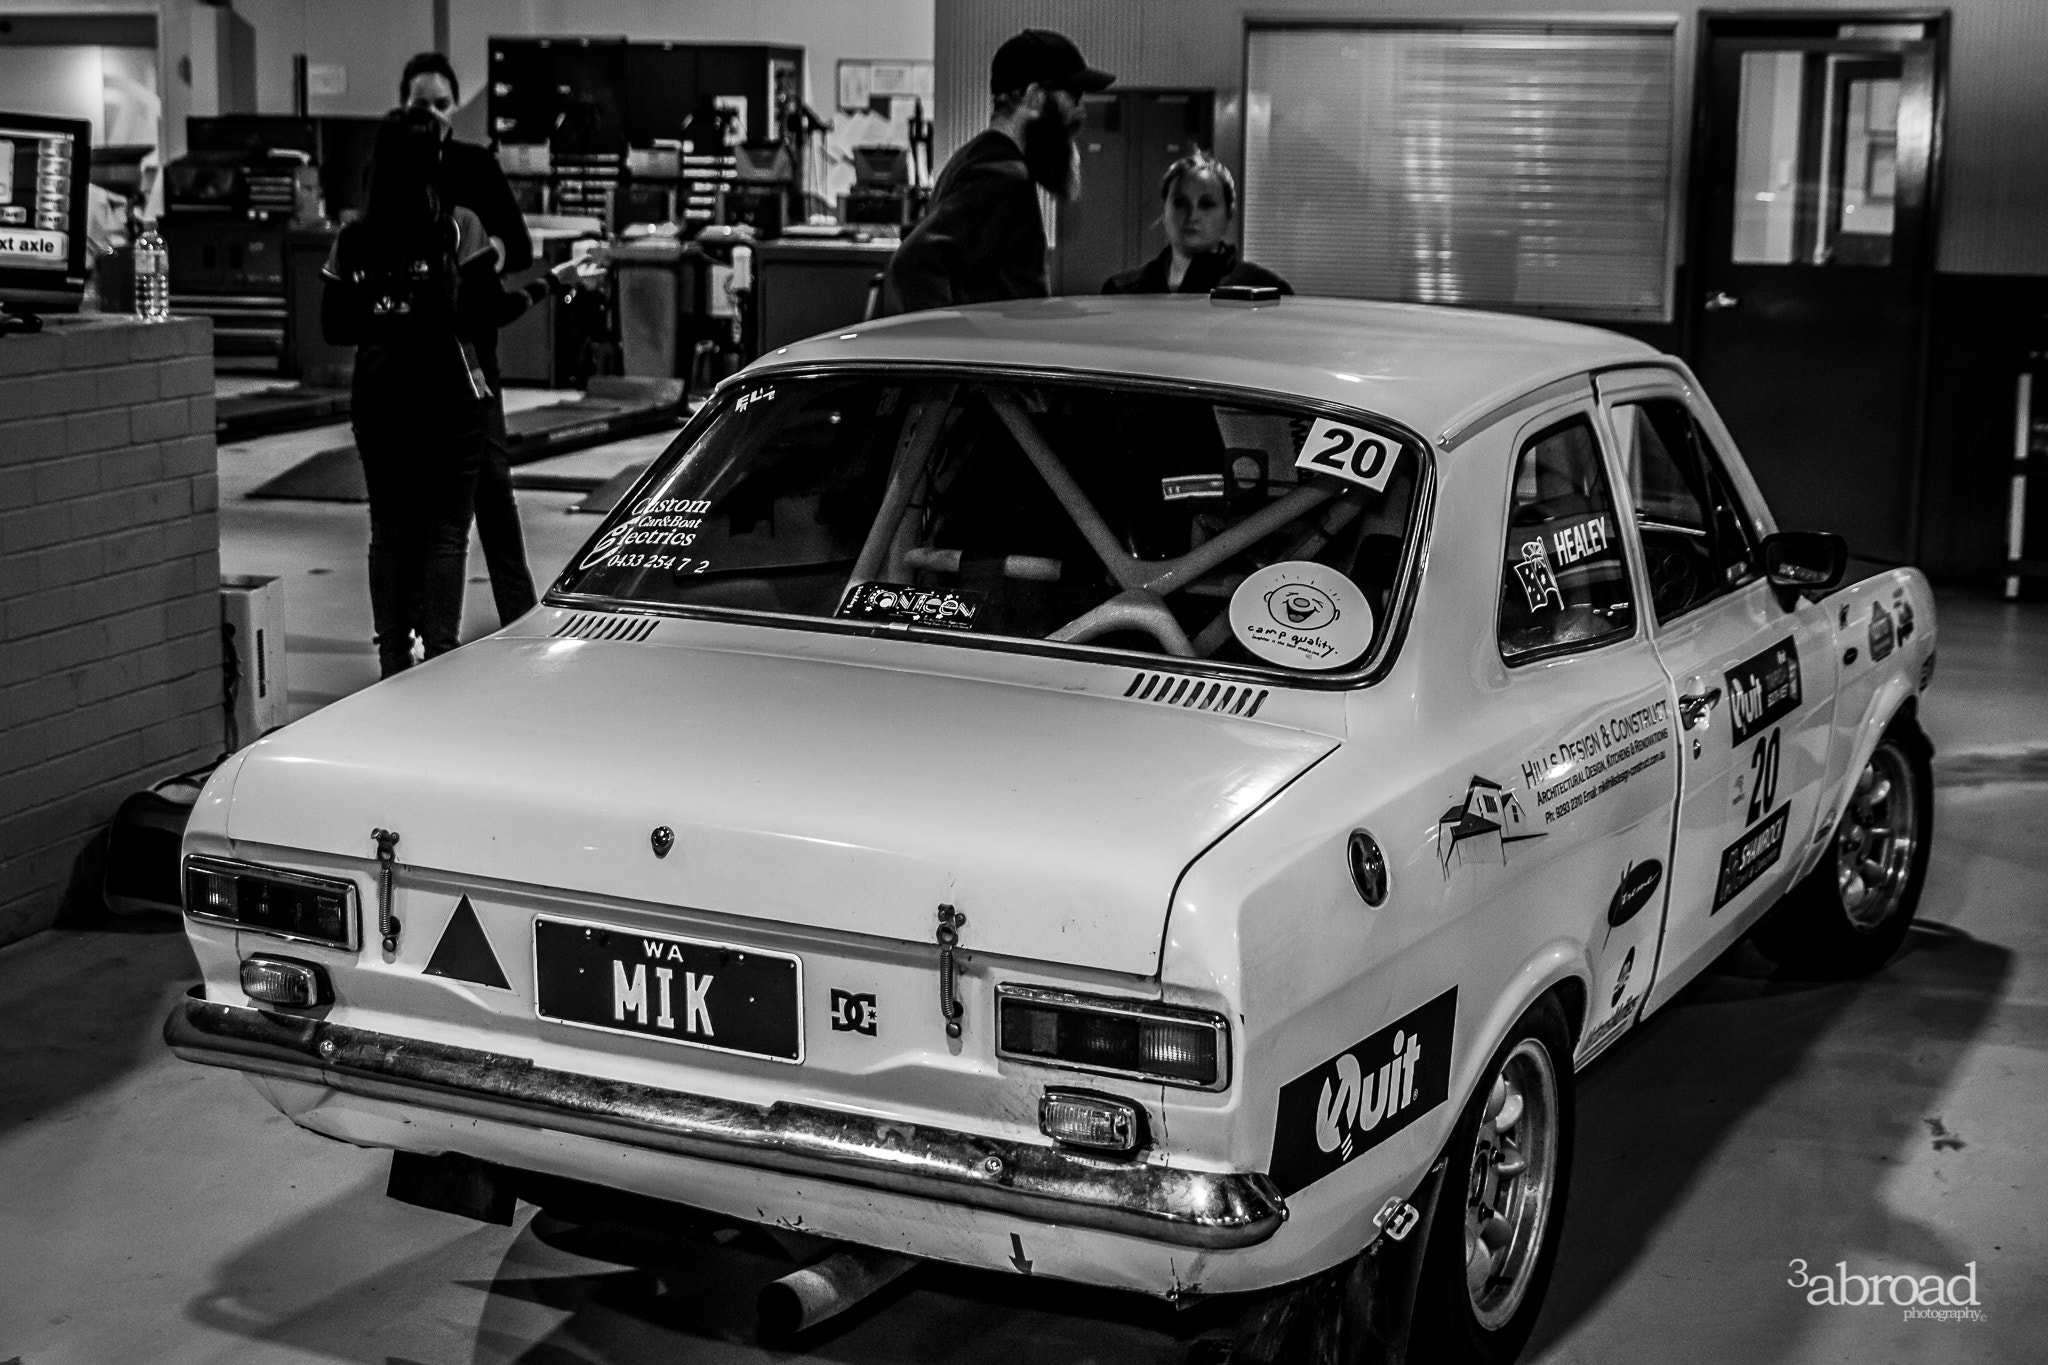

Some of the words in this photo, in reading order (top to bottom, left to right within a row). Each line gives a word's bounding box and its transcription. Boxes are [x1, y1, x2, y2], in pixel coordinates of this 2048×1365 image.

[19, 238, 55, 253] axle
[1311, 427, 1388, 480] 20
[631, 497, 712, 515] Custom
[638, 515, 702, 529] Car&Boat
[1553, 516, 1607, 566] HEALEY
[607, 554, 643, 569] 0433
[644, 555, 676, 570] 254
[1247, 625, 1287, 640] camp
[1729, 673, 1763, 736] Quit
[1600, 723, 1612, 749] &
[1745, 726, 1780, 829] 20
[1555, 804, 1571, 820] 9293
[643, 938, 685, 963] WA
[613, 959, 715, 1037] MIK
[830, 988, 878, 1038] DC
[1315, 1029, 1421, 1162] Quit
